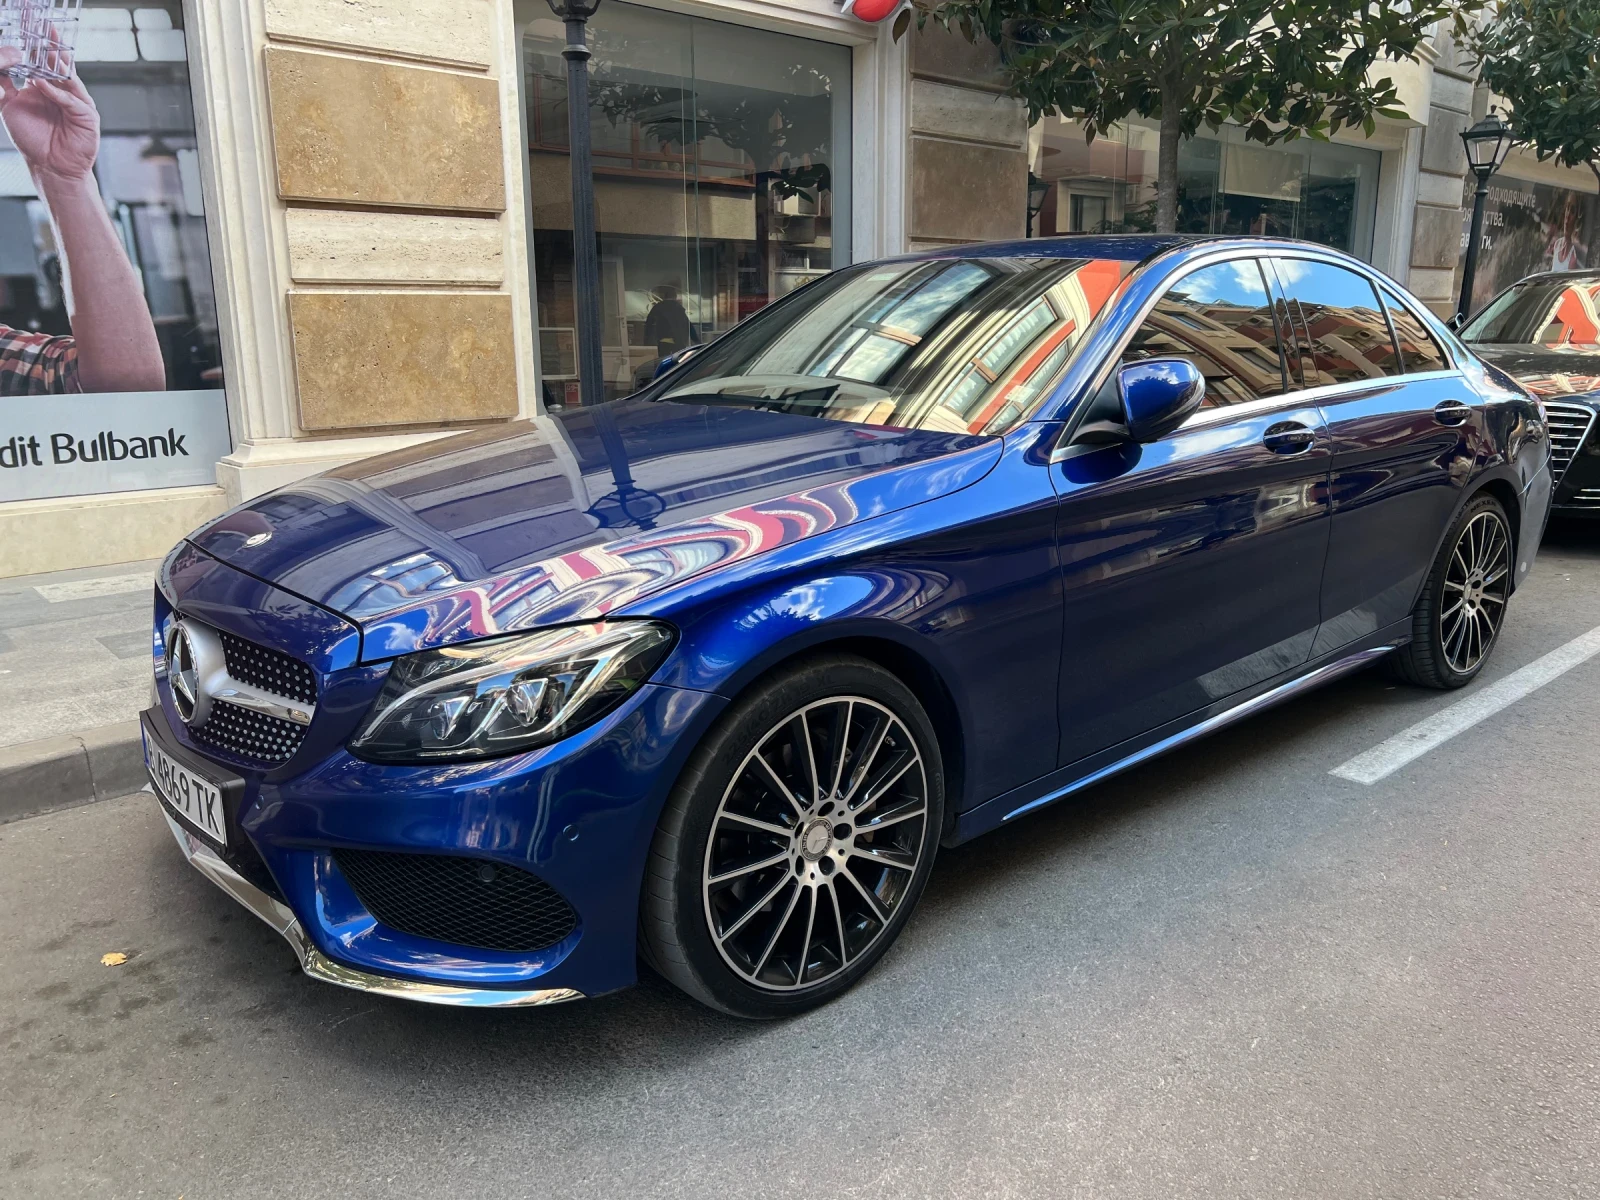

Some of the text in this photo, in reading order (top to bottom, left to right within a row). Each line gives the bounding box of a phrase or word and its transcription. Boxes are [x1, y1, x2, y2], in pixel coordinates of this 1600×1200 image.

[0, 427, 190, 468] dit Bulbank
[158, 751, 190, 813] 4869
[191, 778, 221, 835] TK
